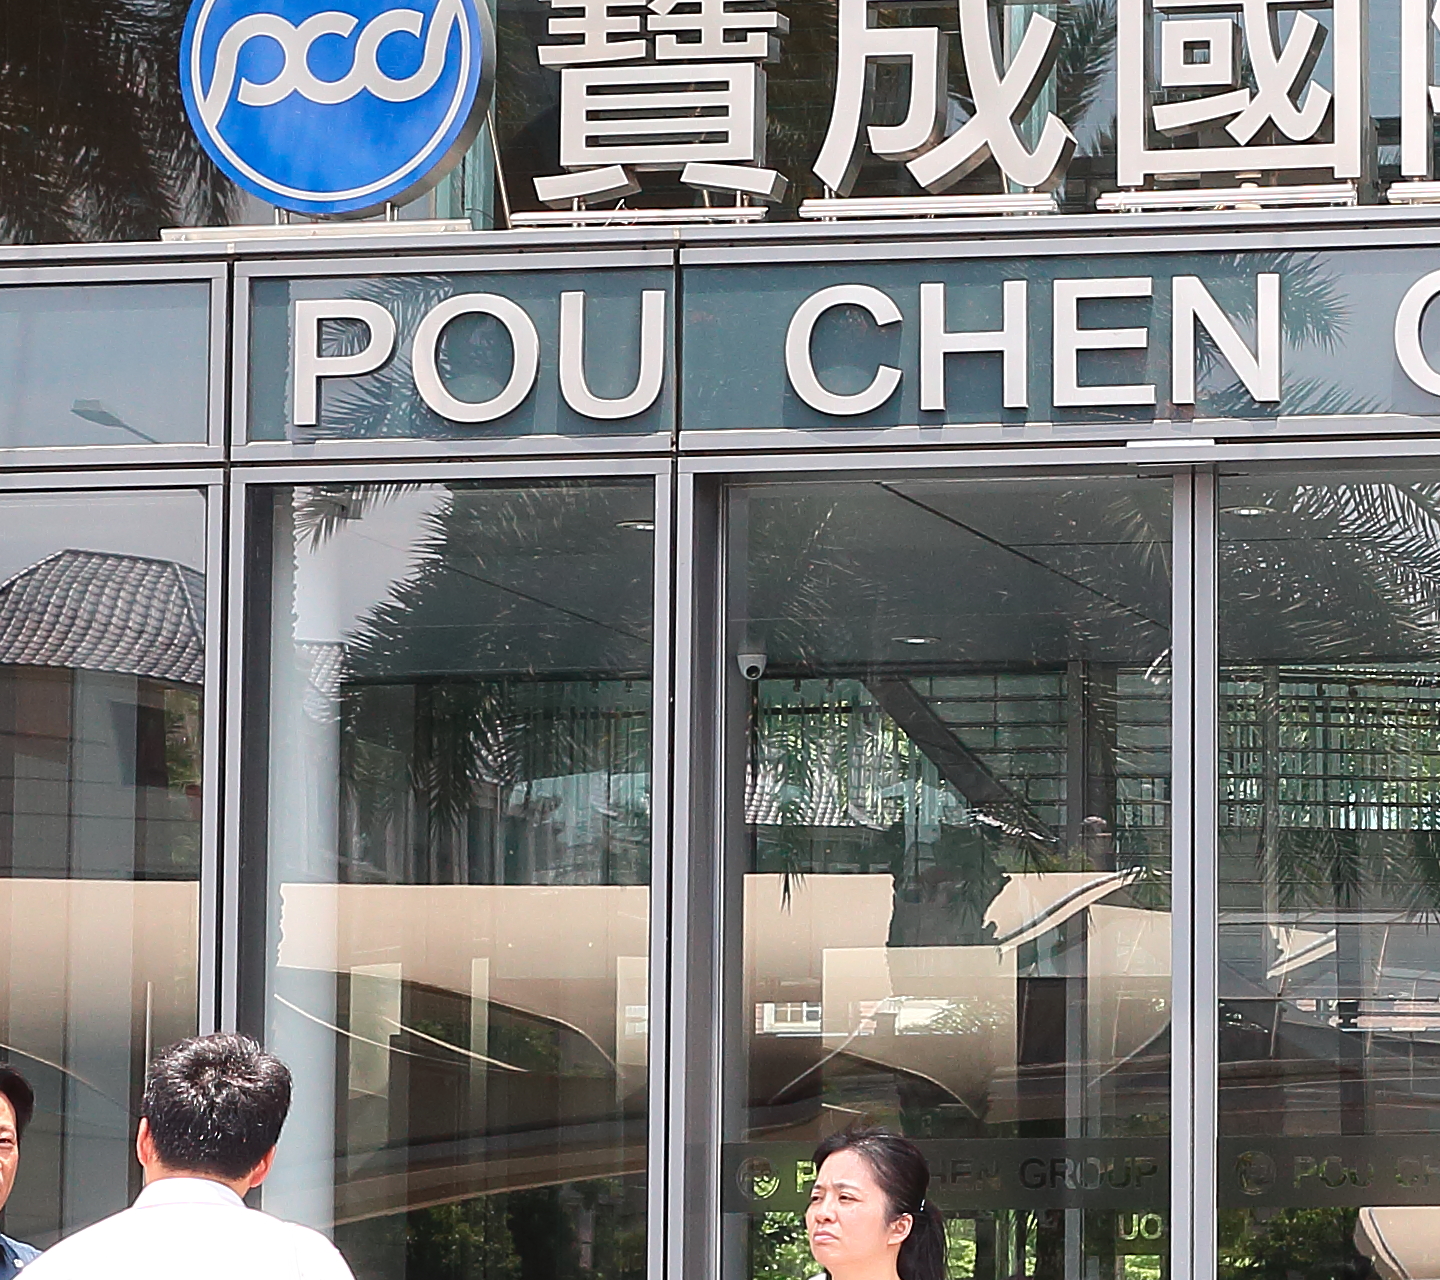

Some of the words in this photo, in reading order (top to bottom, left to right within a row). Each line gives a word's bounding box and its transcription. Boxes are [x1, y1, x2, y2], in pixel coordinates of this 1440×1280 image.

[293, 287, 668, 424] POU
[784, 272, 1284, 416] CHEN
[1018, 1157, 1159, 1189] GROUP
